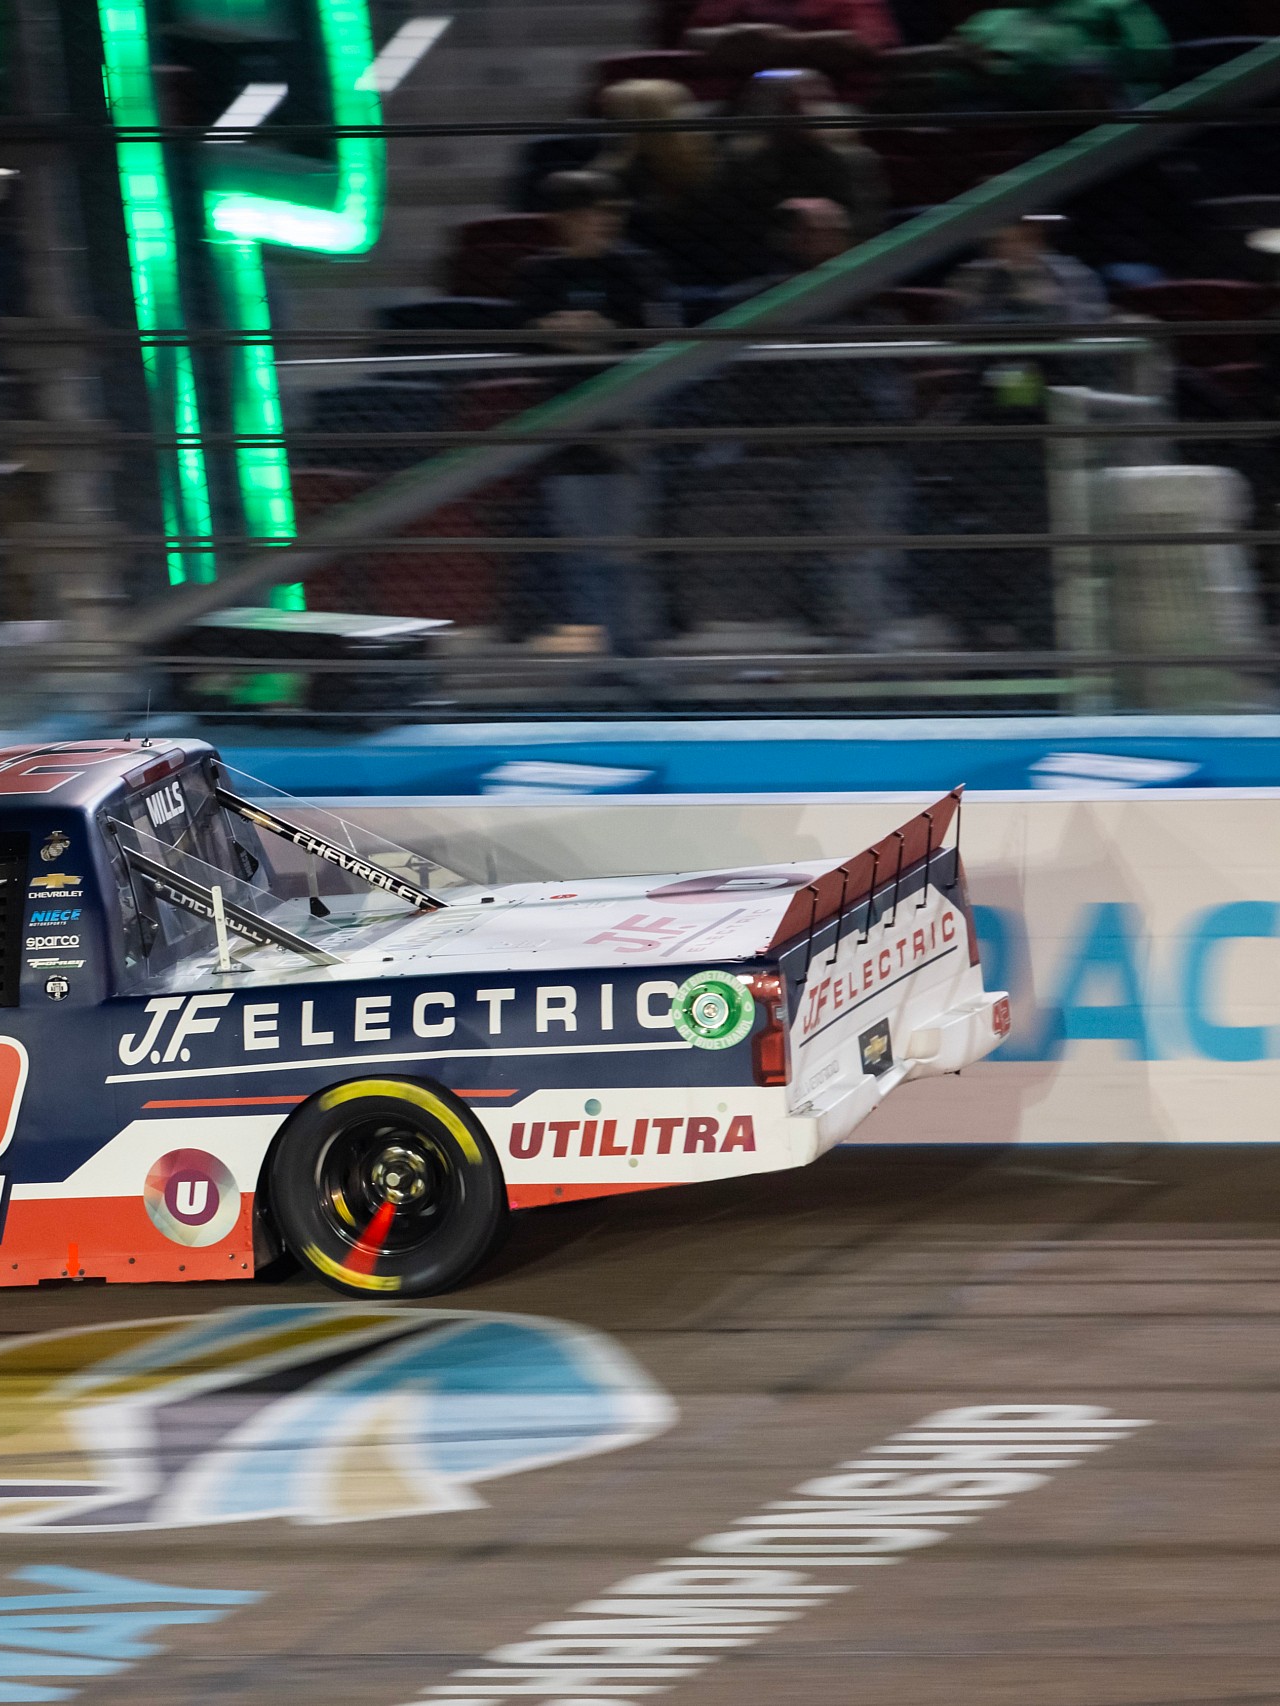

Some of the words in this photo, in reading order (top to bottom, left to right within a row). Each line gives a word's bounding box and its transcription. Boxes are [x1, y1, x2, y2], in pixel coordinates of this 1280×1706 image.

[146, 781, 186, 828] MILLS
[292, 831, 429, 908] CHEVROLET
[28, 890, 83, 899] CHEVROLET
[31, 909, 82, 922] NIECE
[26, 935, 80, 950] sparco
[832, 911, 956, 1010] ELECTRIC
[242, 981, 677, 1052] ELECTRIC
[695, 1020, 753, 1049] BIOETHANOL
[507, 1114, 758, 1160] UTILITRA
[175, 1180, 209, 1215] U
[392, 1404, 1158, 1706] HAMPIONSHIP
